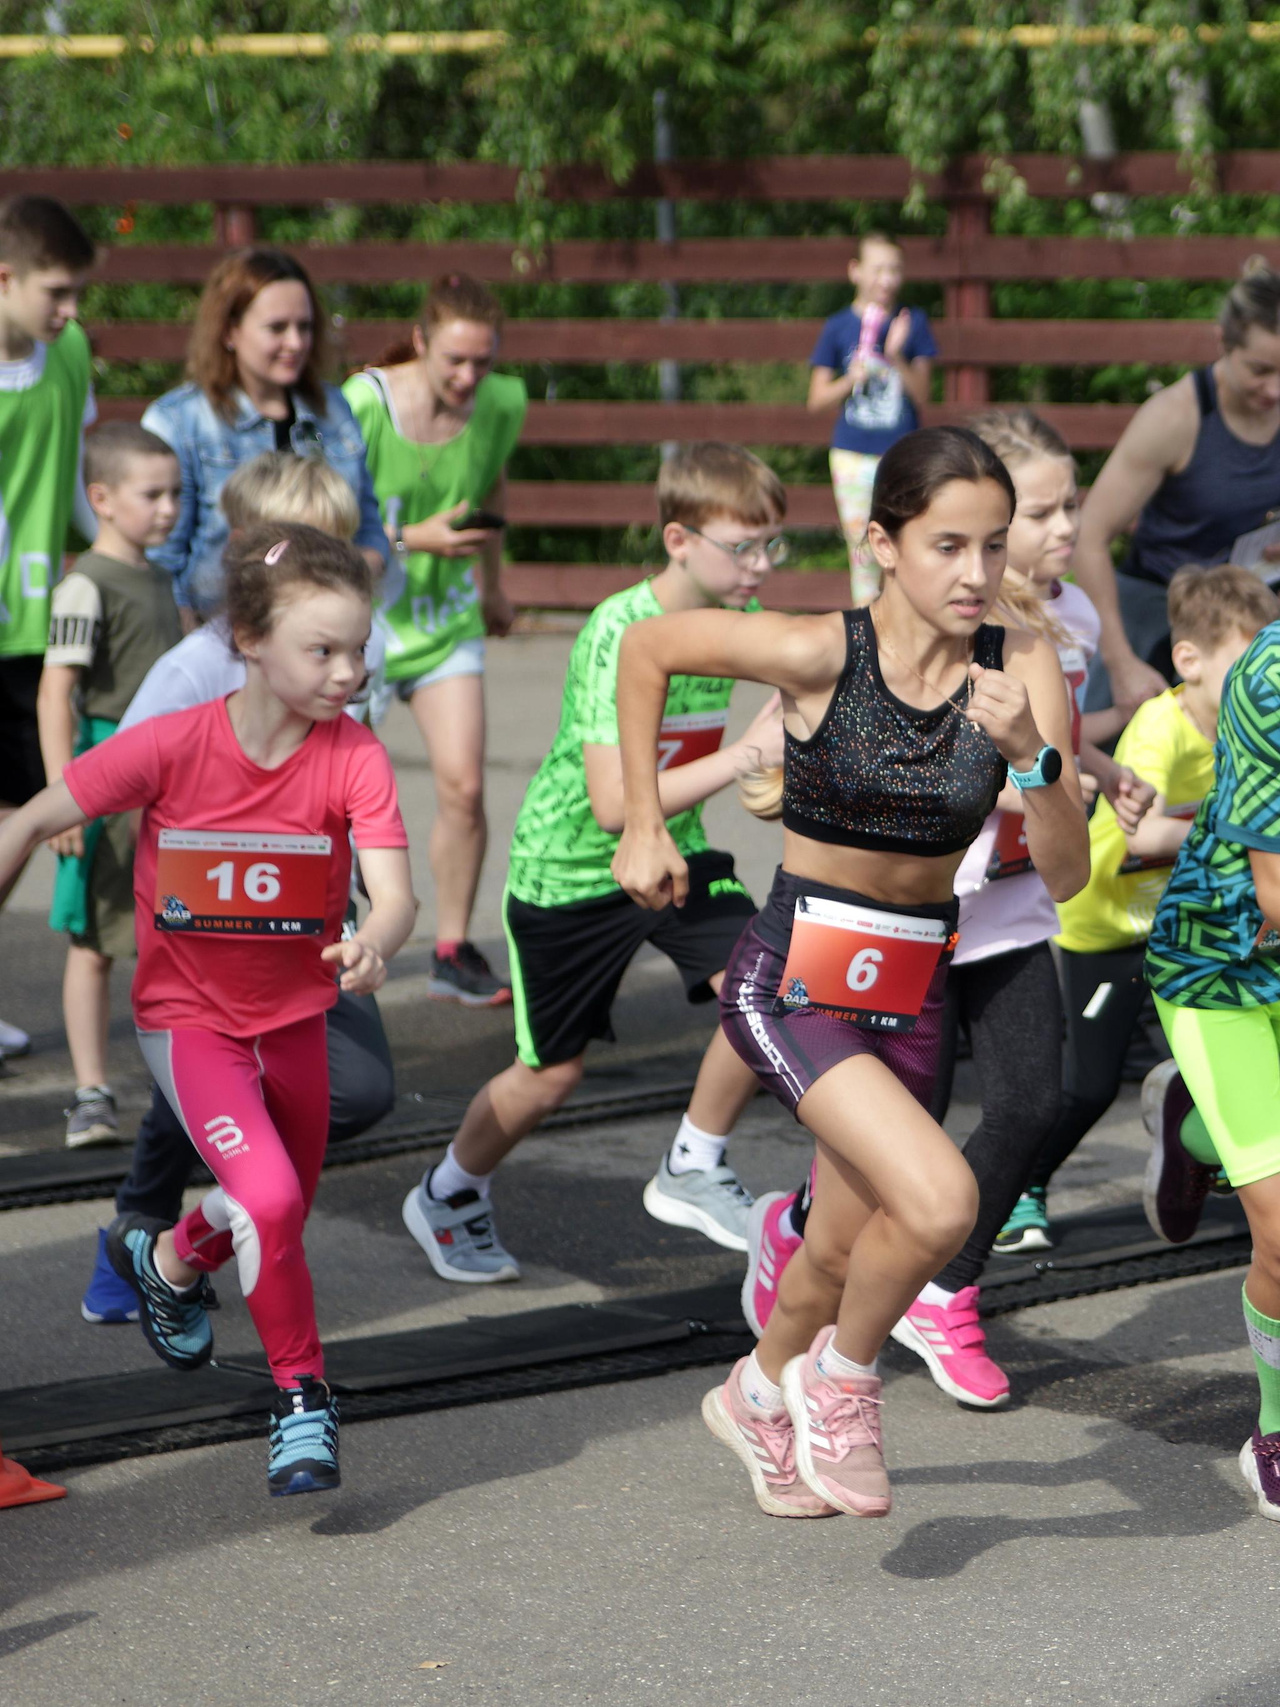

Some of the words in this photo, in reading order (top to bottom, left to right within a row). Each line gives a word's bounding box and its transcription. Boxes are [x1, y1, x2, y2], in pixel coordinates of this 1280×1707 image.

[206, 860, 281, 902] 16
[161, 909, 191, 920] DAB
[194, 920, 253, 930] SUMMER
[268, 921, 276, 931] 1
[281, 921, 302, 932] KM
[846, 947, 883, 992] 6
[783, 993, 809, 1005] DAB
[869, 1015, 876, 1024] 1
[880, 1017, 898, 1027] KM
